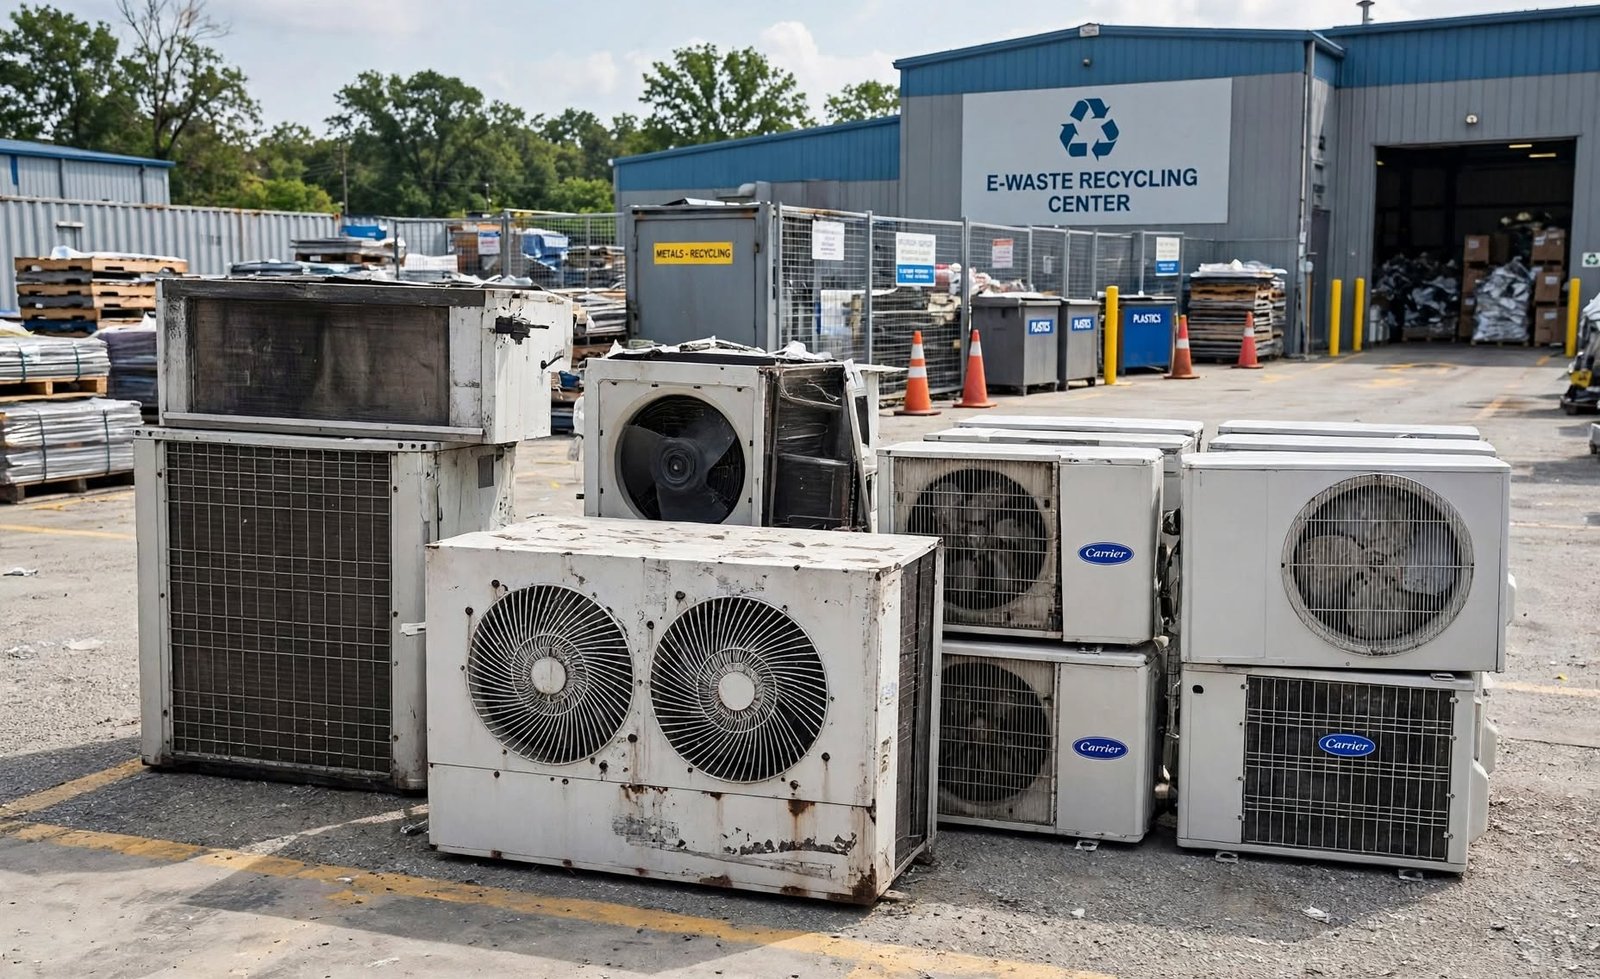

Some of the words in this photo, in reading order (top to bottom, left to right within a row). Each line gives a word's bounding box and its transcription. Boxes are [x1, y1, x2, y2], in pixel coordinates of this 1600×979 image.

[986, 172, 1073, 192] E-WASTE
[1079, 168, 1198, 189] RECYCLING
[1048, 194, 1130, 213] CENTER
[656, 249, 683, 258] METALS
[690, 248, 731, 258] RECYCLING
[1133, 314, 1161, 324] PLASTICS
[1085, 547, 1127, 558] Carrier
[1080, 741, 1122, 754] Carrier
[1325, 738, 1369, 751] Carrier
